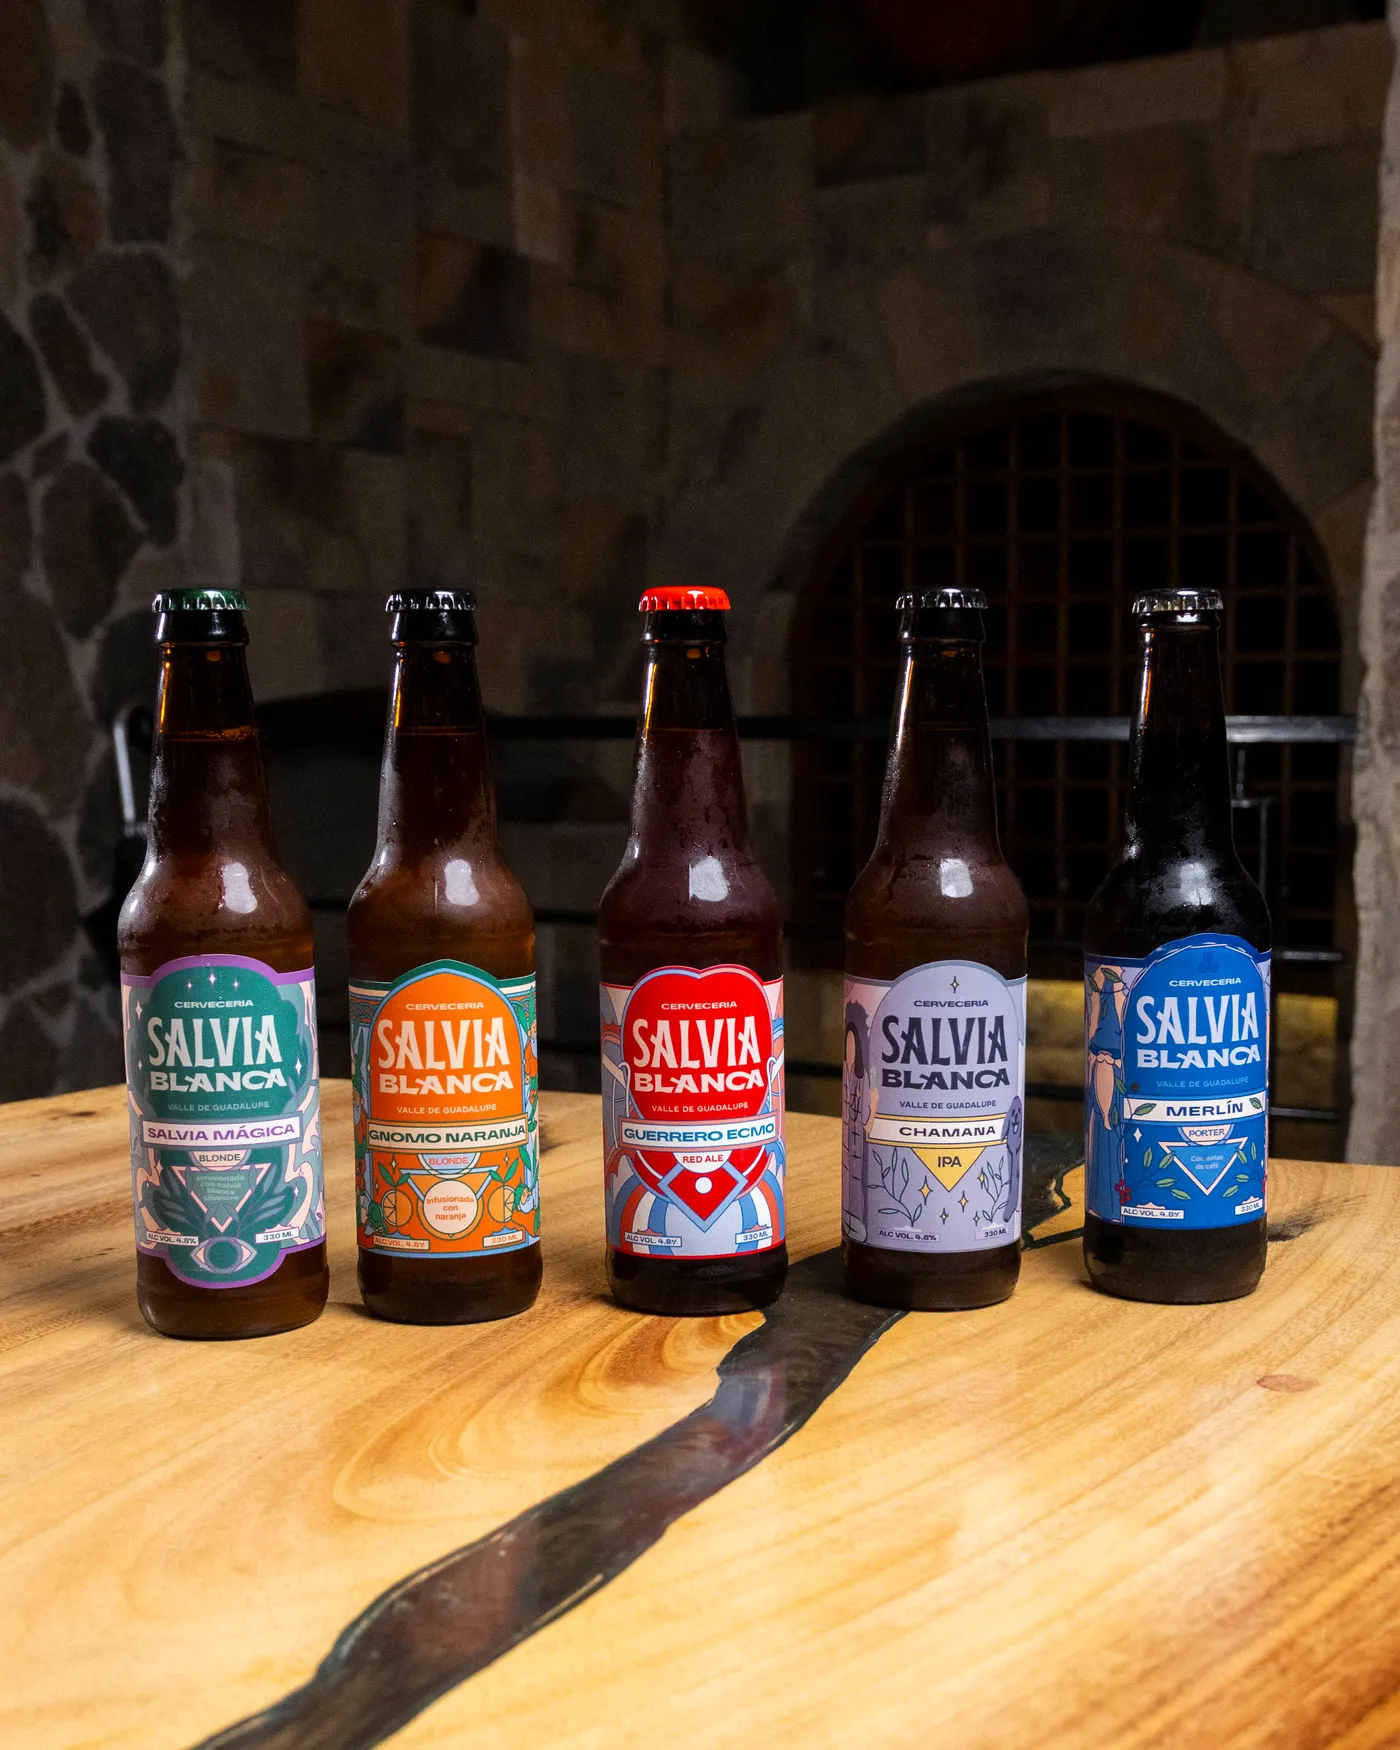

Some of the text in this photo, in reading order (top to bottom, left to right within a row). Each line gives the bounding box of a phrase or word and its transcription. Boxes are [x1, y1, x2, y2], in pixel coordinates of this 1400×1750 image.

[1169, 977, 1242, 987] CERVECERIA
[174, 1000, 254, 1008] CERVECERIA
[405, 1001, 484, 1010] CERVECERIA
[661, 1001, 737, 1010] CERVECERIA
[913, 1000, 989, 1008] CERVECERIA
[1136, 992, 1259, 1045] SALVIA
[148, 1015, 282, 1067] SALVIA
[377, 1017, 510, 1070] SALVIA
[632, 1016, 761, 1069] SALVIA
[881, 1015, 1008, 1066] SALVIA
[1137, 1044, 1261, 1069] BLANCA
[150, 1068, 287, 1093] BLANCA
[379, 1071, 514, 1095] BLANCA
[634, 1069, 764, 1094] BLANCA
[881, 1068, 1010, 1090] BLANCA
[1156, 1077, 1249, 1088] VALLE DE GUADALUPE
[168, 1104, 195, 1112] VALLE
[212, 1101, 270, 1111] GUADALUPE
[396, 1103, 497, 1114] VALLE DE GUADALUPE
[651, 1102, 749, 1113] VALLE DE GUADALUPE
[900, 1099, 997, 1109] VALLE DE GUADALUPE
[1166, 1100, 1243, 1117] MERLÍN
[147, 1125, 295, 1141] SALVIA MÁGICA
[369, 1125, 525, 1143] GNOMO NARANJA
[624, 1123, 774, 1142] GUERRERO ECMO
[899, 1126, 996, 1137] CHAMANA
[1188, 1128, 1226, 1138] PORTER
[199, 1154, 241, 1162] BLONDE
[428, 1156, 469, 1165] BLONDE
[682, 1154, 724, 1163] RED ALE
[937, 1156, 962, 1168] IPA
[1140, 1209, 1158, 1217] VOL.
[1240, 1205, 1253, 1213] 330
[435, 1213, 466, 1221] naranja
[160, 1234, 175, 1243] VOL.
[176, 1236, 196, 1244] 4.8%
[640, 1236, 656, 1244] VOL.
[878, 1230, 893, 1238] ALC
[895, 1232, 913, 1240] VOL.
[375, 1237, 386, 1245] ALC
